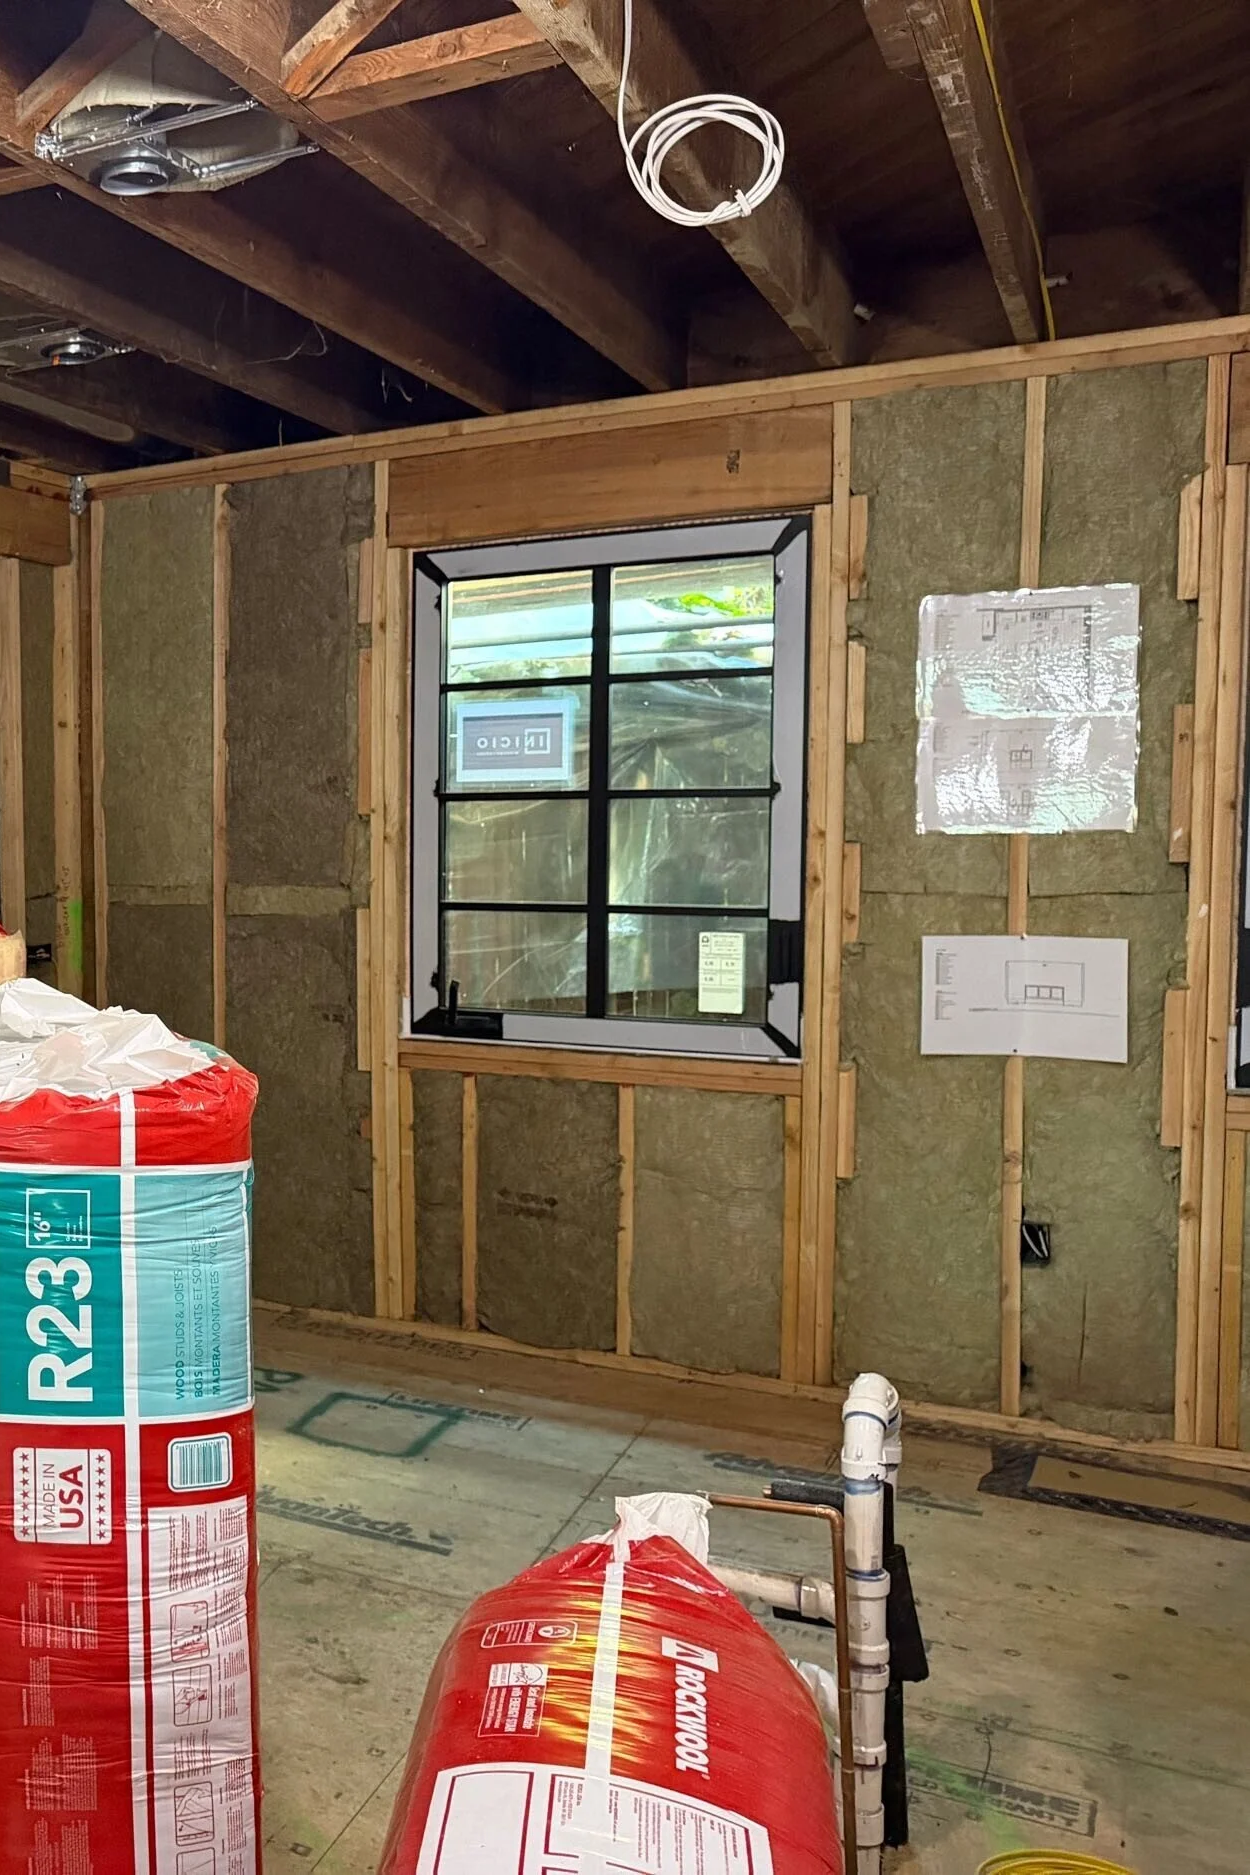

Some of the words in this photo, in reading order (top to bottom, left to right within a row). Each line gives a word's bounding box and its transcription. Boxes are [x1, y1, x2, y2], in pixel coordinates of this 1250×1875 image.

[33, 1211, 51, 1242] 16"
[190, 1239, 202, 1285] SOLIVES
[173, 1269, 184, 1307] JOISTS
[192, 1287, 202, 1301] ET
[210, 1271, 221, 1343] MONTANTES
[26, 1257, 94, 1402] R23
[174, 1309, 185, 1319] &
[174, 1322, 185, 1357] STUDS
[193, 1304, 204, 1368] MONTANTS
[174, 1360, 185, 1400] WOOD
[193, 1371, 204, 1398] BOIS
[211, 1345, 221, 1396] MADERA
[42, 1463, 55, 1478] IN
[42, 1482, 56, 1528] MADE
[59, 1464, 84, 1529] USA
[675, 1663, 709, 1774] ROCKWOOL
